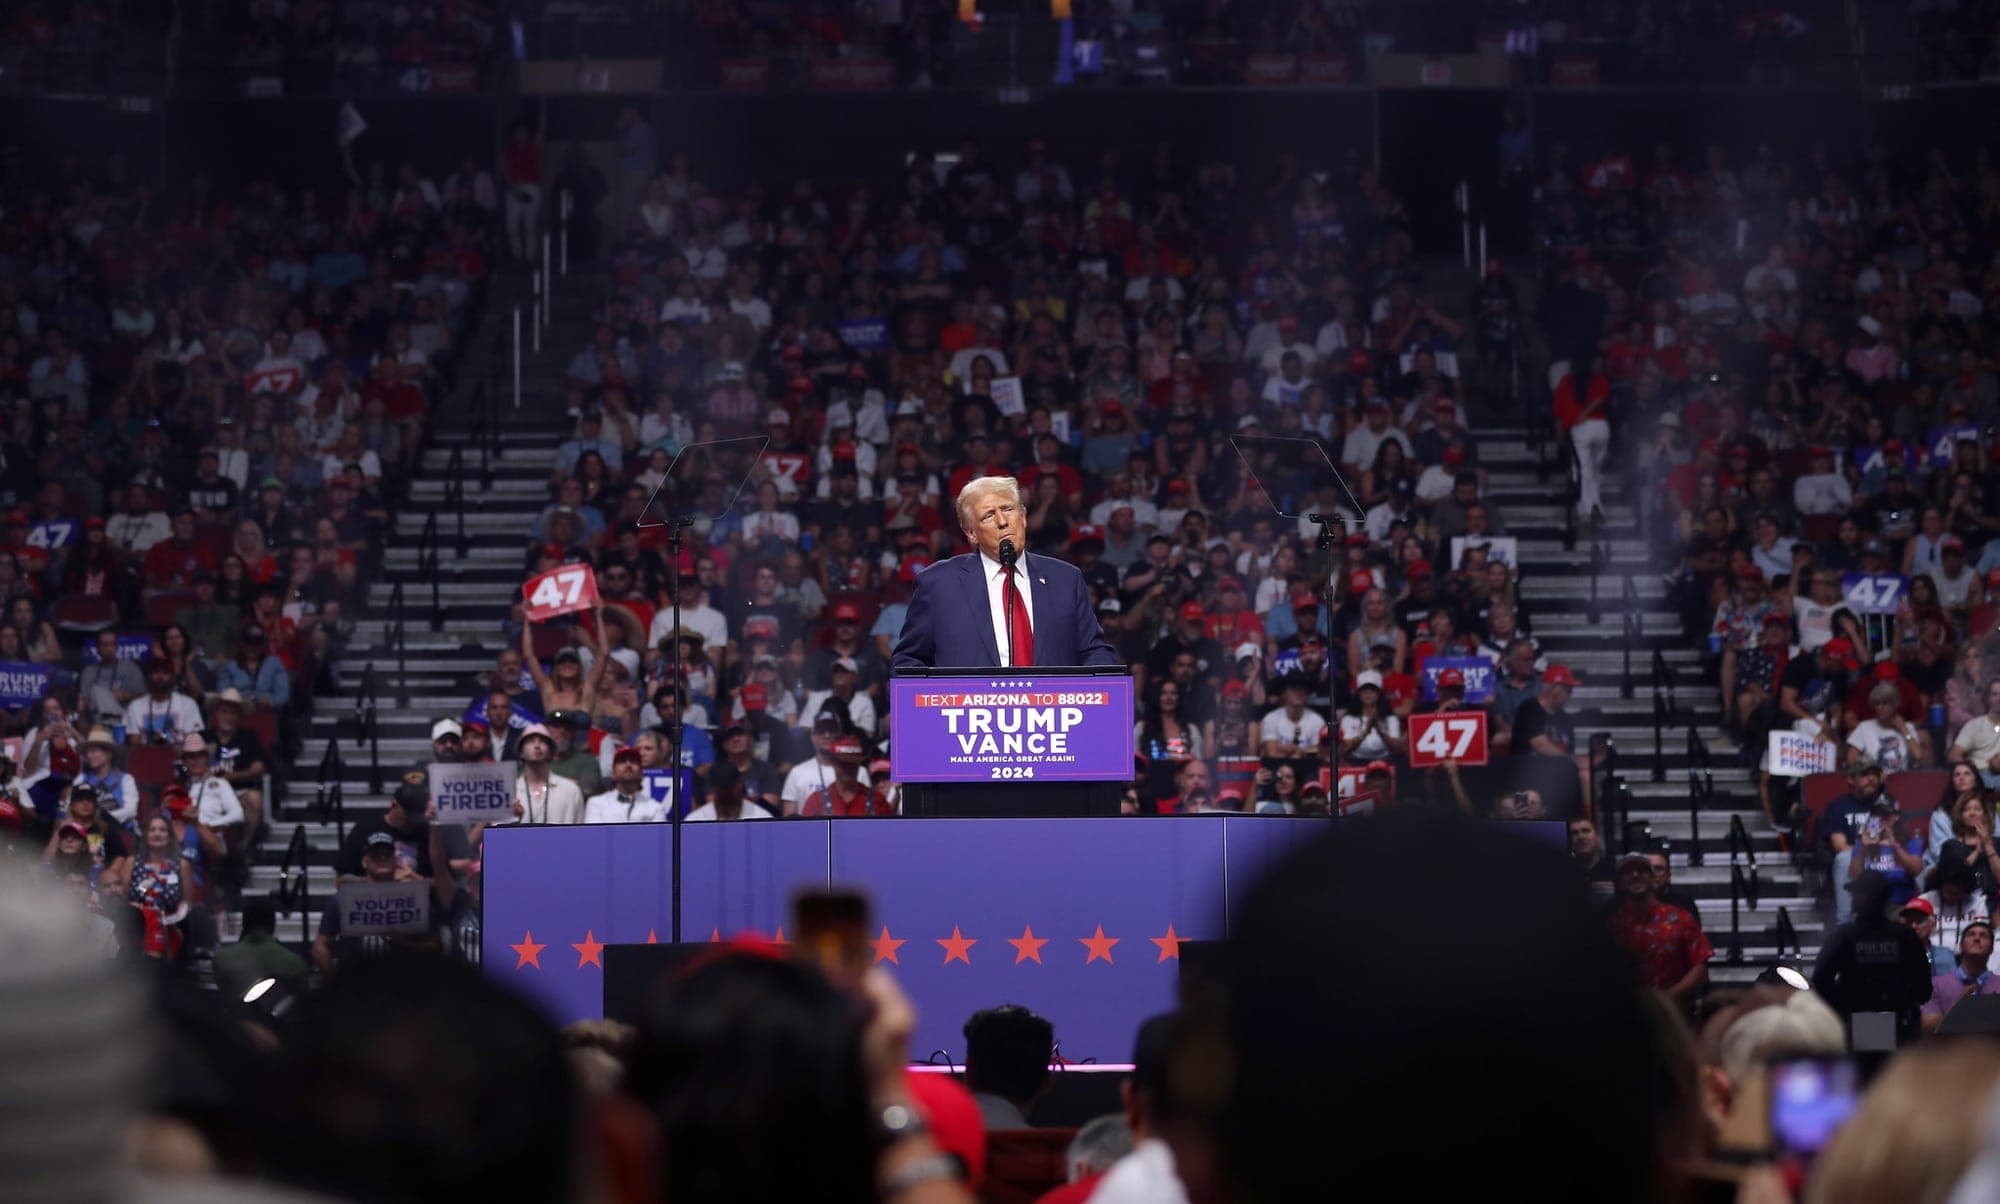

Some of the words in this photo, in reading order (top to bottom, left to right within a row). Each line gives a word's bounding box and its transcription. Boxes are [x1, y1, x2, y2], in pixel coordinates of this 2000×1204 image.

[26, 522, 72, 549] 47
[530, 569, 586, 609] 47
[1848, 577, 1902, 607] 47
[0, 672, 48, 685] RUMP
[1426, 666, 1491, 680] TMP
[922, 694, 958, 706] TEXT
[962, 693, 1030, 706] ARIZONA
[1034, 693, 1054, 705] TO
[1058, 693, 1103, 705] 88022
[941, 707, 1083, 734] TRUMP
[957, 733, 1067, 755] VANCE
[1415, 719, 1479, 759] 47
[1016, 755, 1043, 763] GREAT
[991, 766, 1034, 779] 2024
[443, 780, 504, 793] YOU'RE
[438, 793, 510, 811] FIRED!
[355, 896, 416, 911] YOU'RE
[349, 908, 421, 926] FIRED!
[1856, 942, 1897, 954] POLICE
